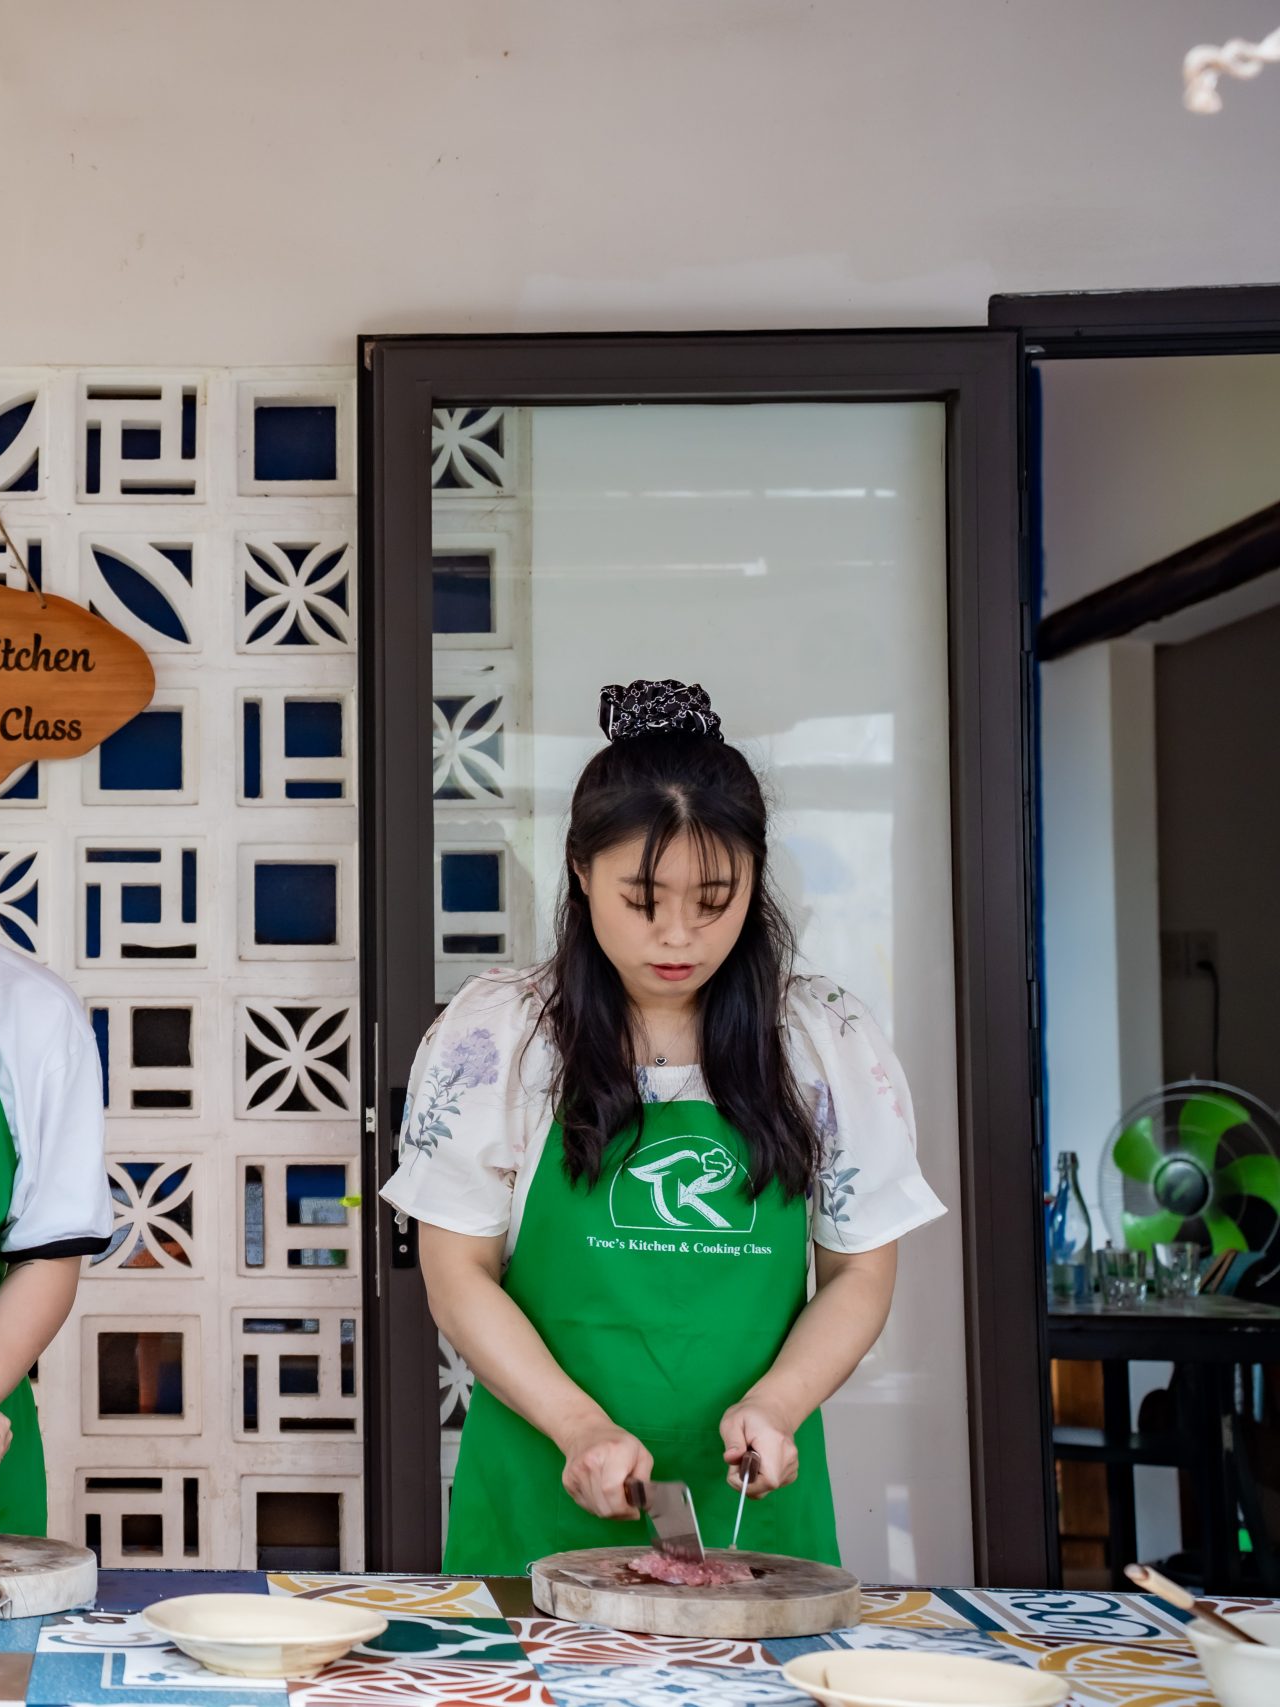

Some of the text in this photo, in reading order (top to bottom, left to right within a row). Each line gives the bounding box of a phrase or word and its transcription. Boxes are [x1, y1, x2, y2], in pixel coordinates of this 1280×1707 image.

[0, 705, 83, 742] Class
[586, 1236, 772, 1257] Troc's Kitchen & Cooking Class
